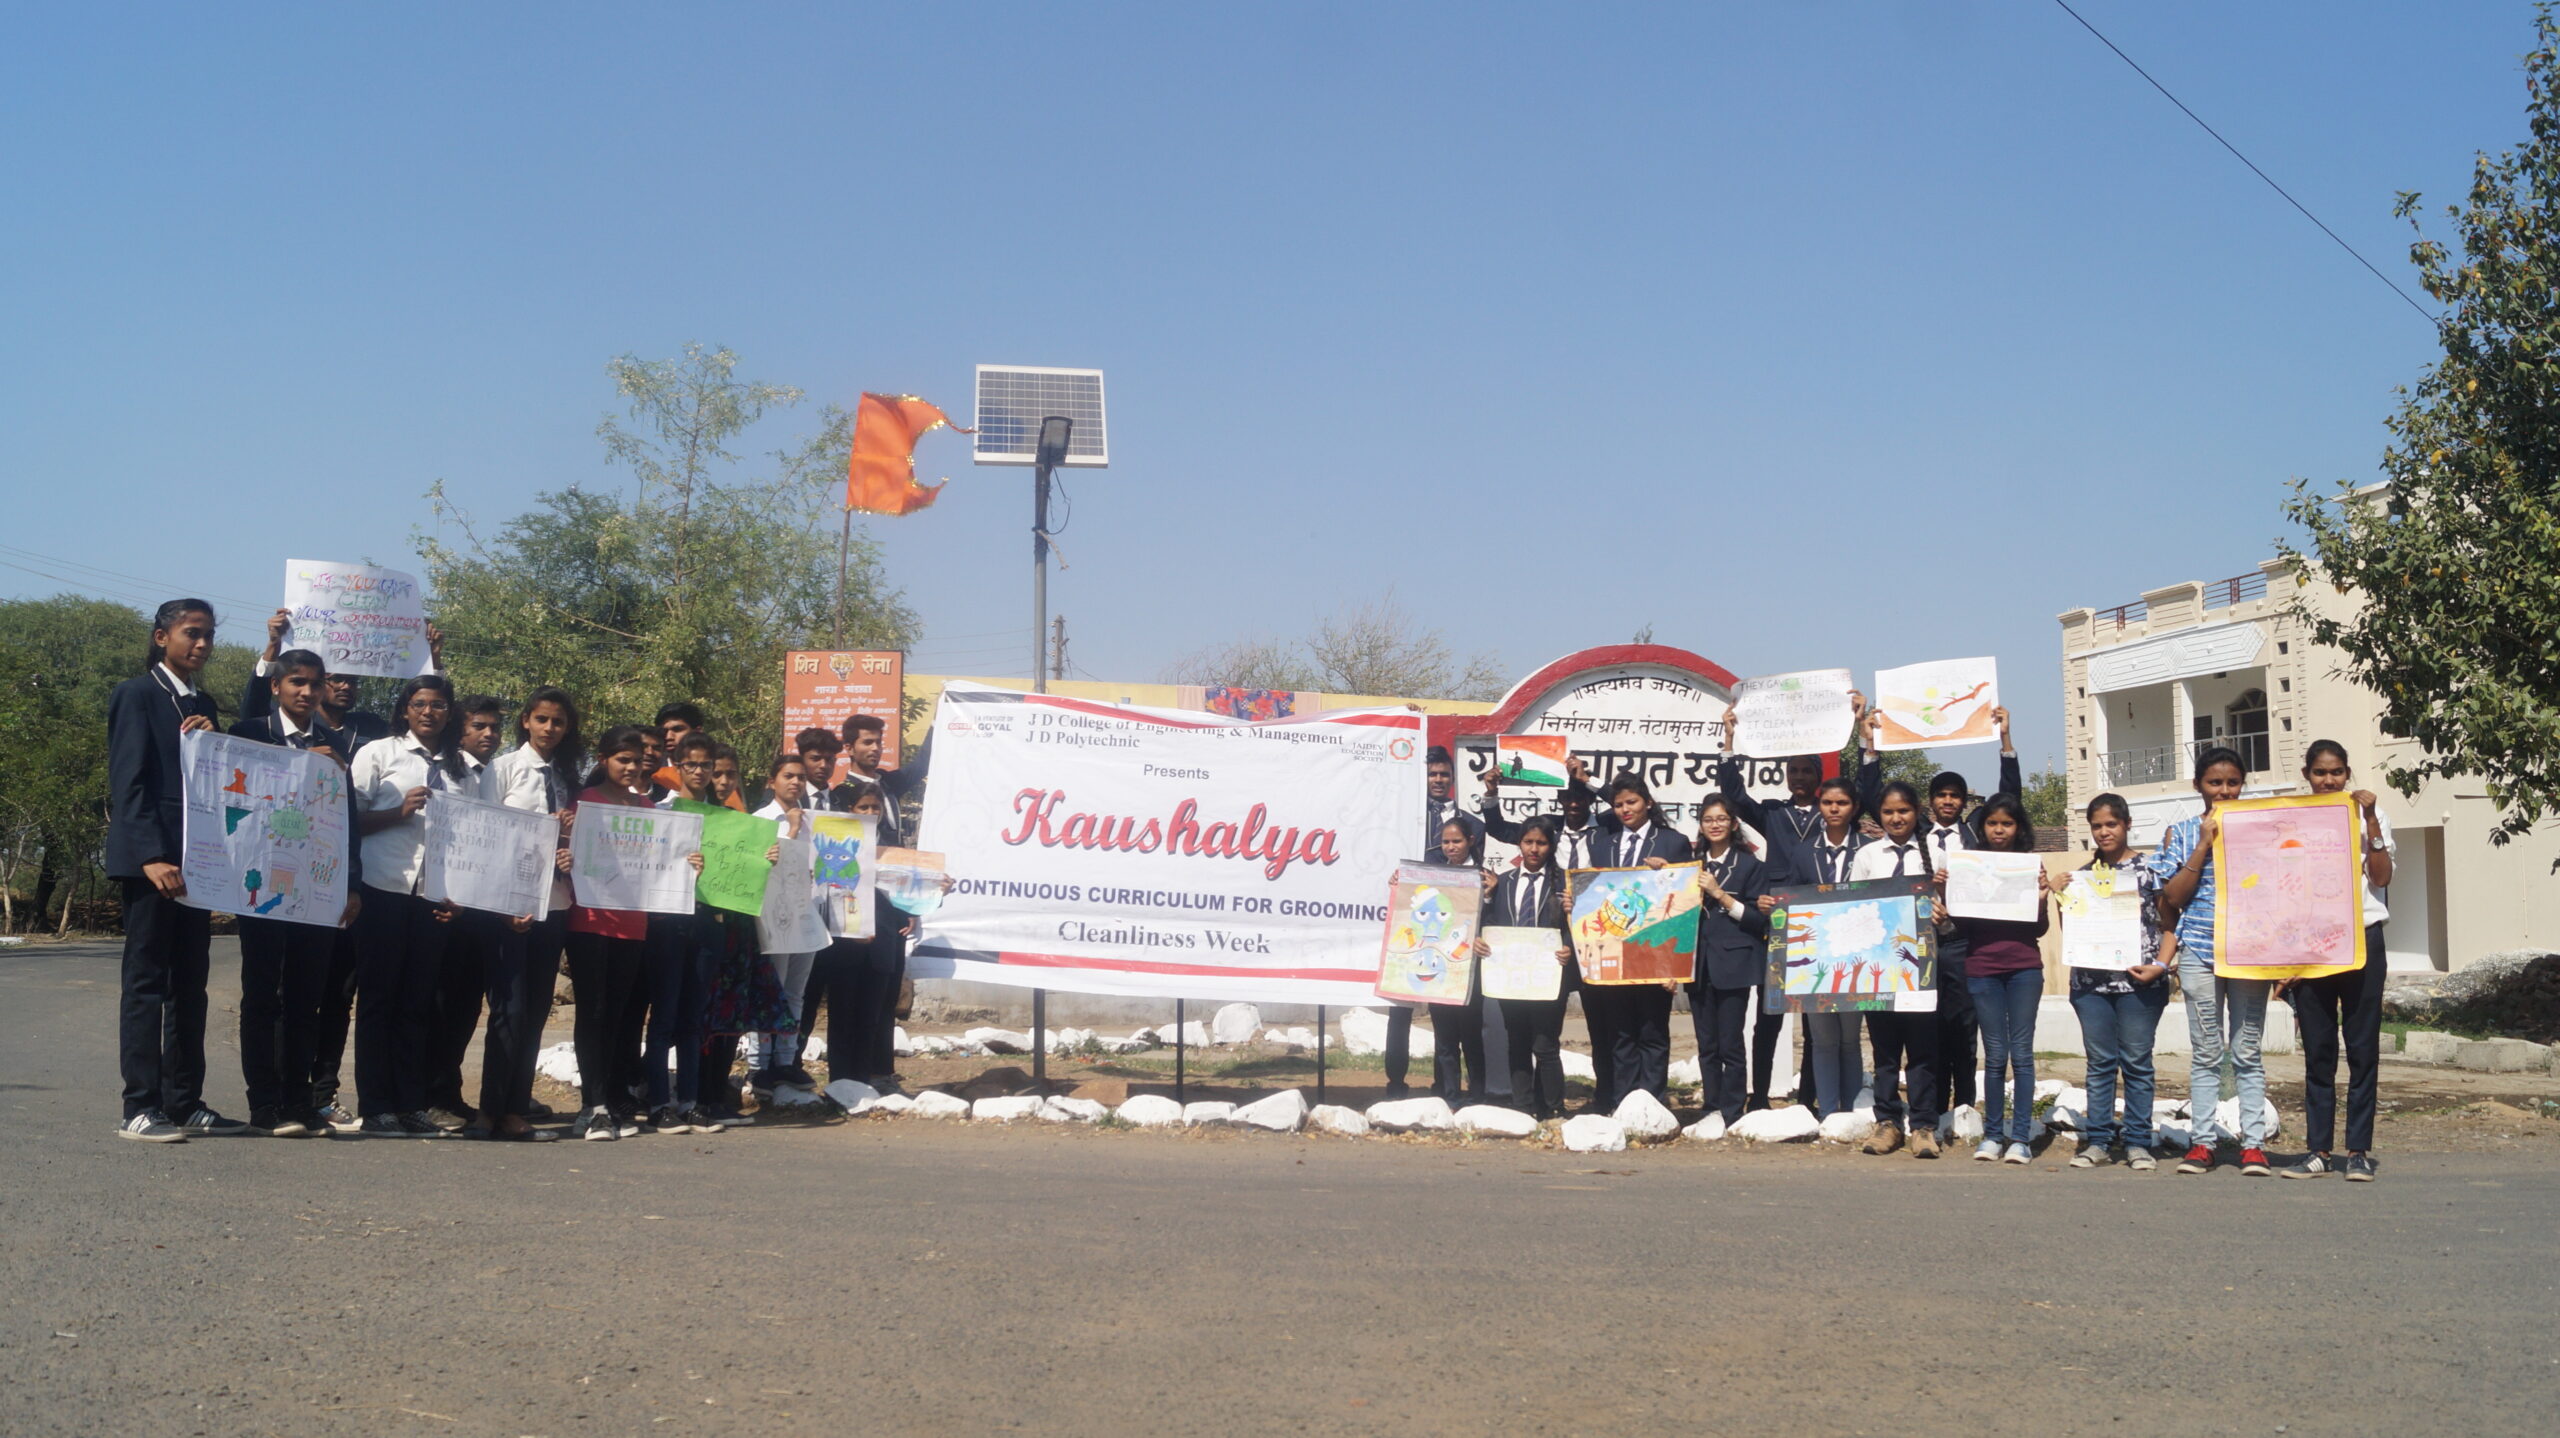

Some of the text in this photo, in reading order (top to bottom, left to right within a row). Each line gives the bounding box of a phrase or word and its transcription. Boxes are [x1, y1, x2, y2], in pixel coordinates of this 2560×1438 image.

[346, 575, 375, 591] YOU
[297, 606, 336, 624] YOUR
[334, 648, 394, 666] DIRTY
[794, 654, 892, 675] शिव सेना
[1741, 680, 1764, 691] THEY
[1766, 679, 1790, 690] GAVE
[1766, 692, 1803, 703] MOTHER
[978, 722, 1012, 732] GOYAL
[1028, 713, 1037, 726] J
[1042, 714, 1053, 727] D
[1058, 714, 1112, 732] College
[1230, 727, 1243, 737] &
[1249, 727, 1344, 745] Management
[1540, 711, 1596, 737] निर्मल
[1639, 714, 1704, 743] तंटामुक्त
[1763, 719, 1795, 729] CLEAN
[1025, 731, 1141, 748] J D Polytechnic
[1143, 764, 1210, 780] Presents
[1001, 787, 1341, 882] Kaushalya
[1088, 886, 1226, 912] CURRICULUM
[1232, 896, 1273, 914] FOR
[1279, 899, 1388, 922] GROOMING
[1058, 920, 1271, 955] Cleanliness Week
